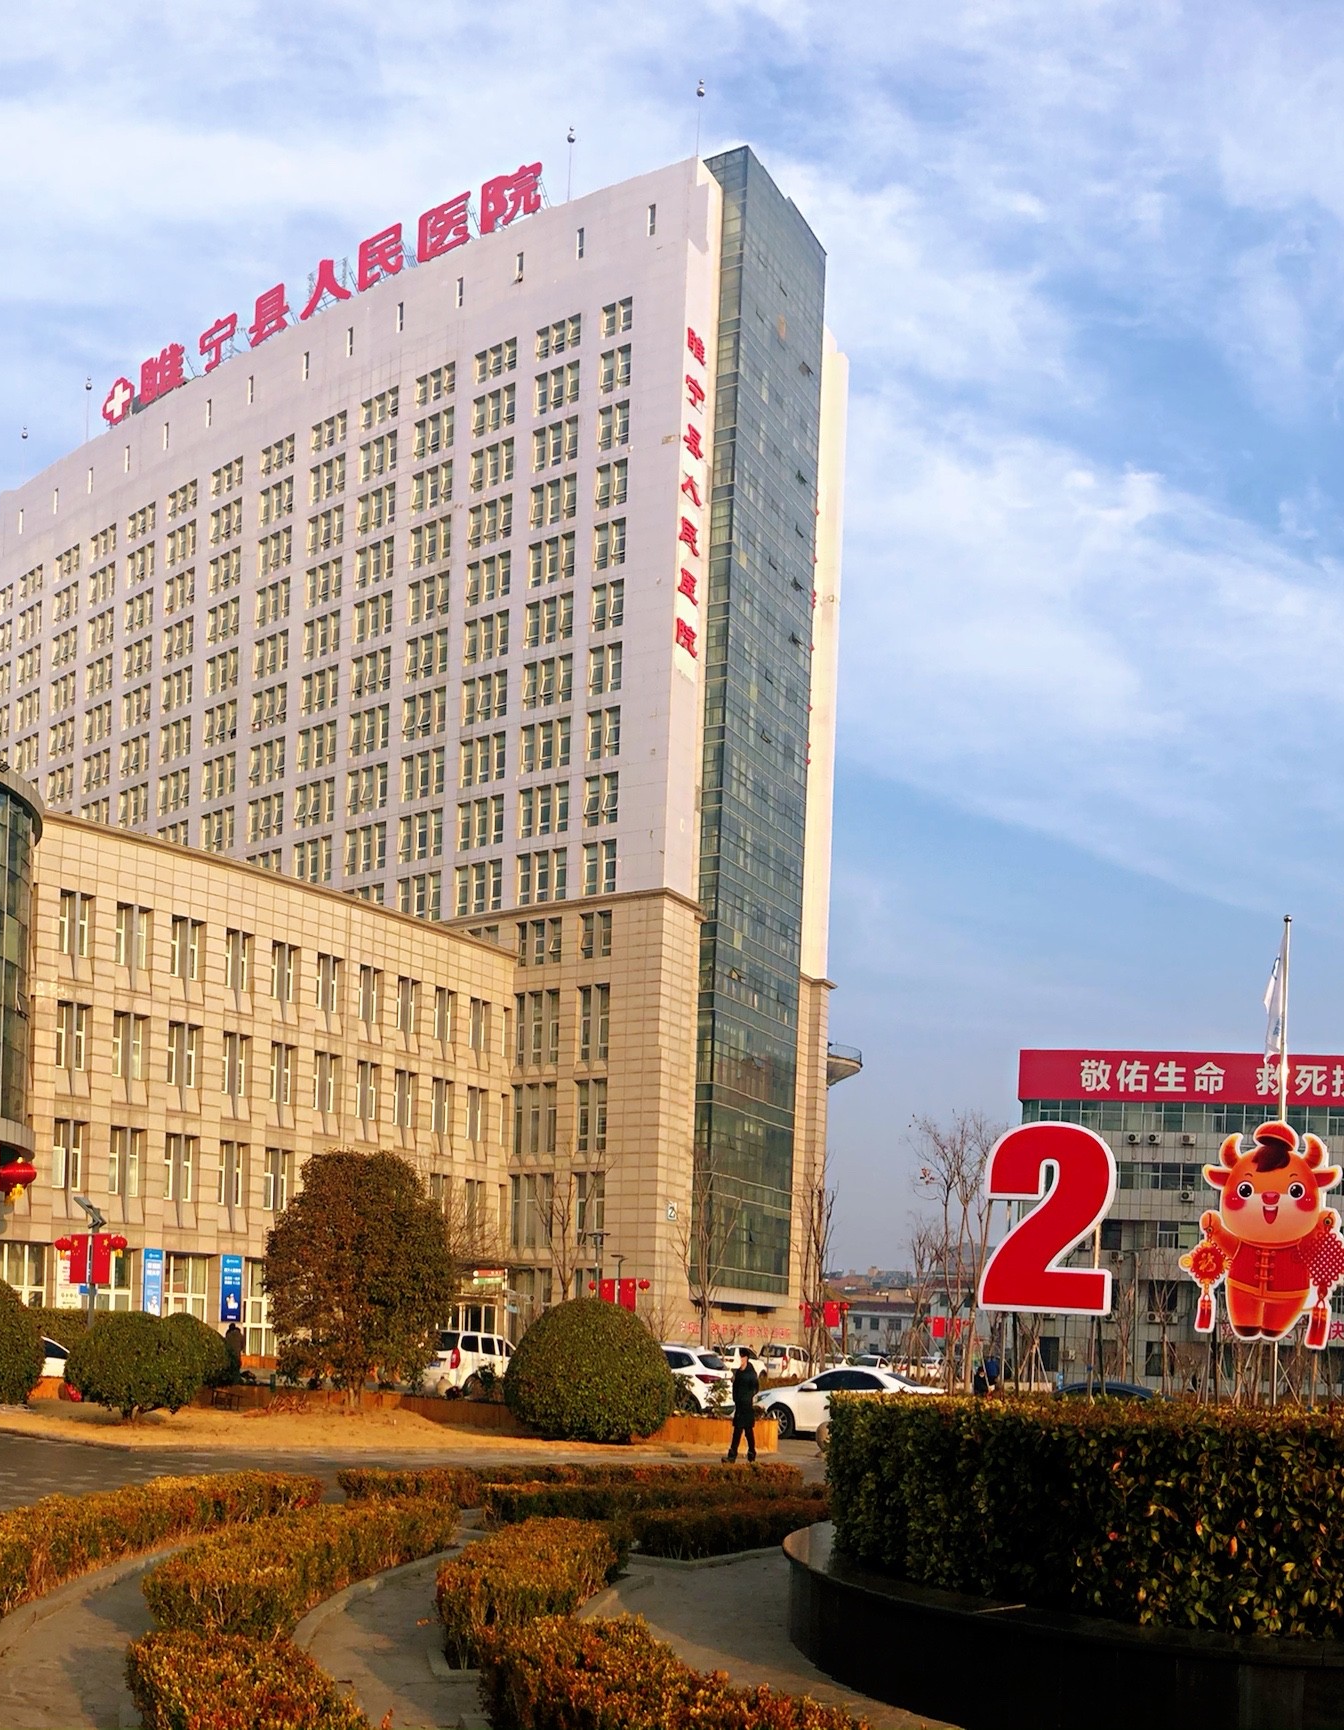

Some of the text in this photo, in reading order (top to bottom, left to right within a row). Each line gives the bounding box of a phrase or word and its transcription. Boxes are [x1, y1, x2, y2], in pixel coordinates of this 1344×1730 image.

[140, 161, 543, 404] 睢宁县人民医院
[674, 327, 707, 658] 睢宁县人民医院
[1080, 1060, 1226, 1094] 敬佑生命
